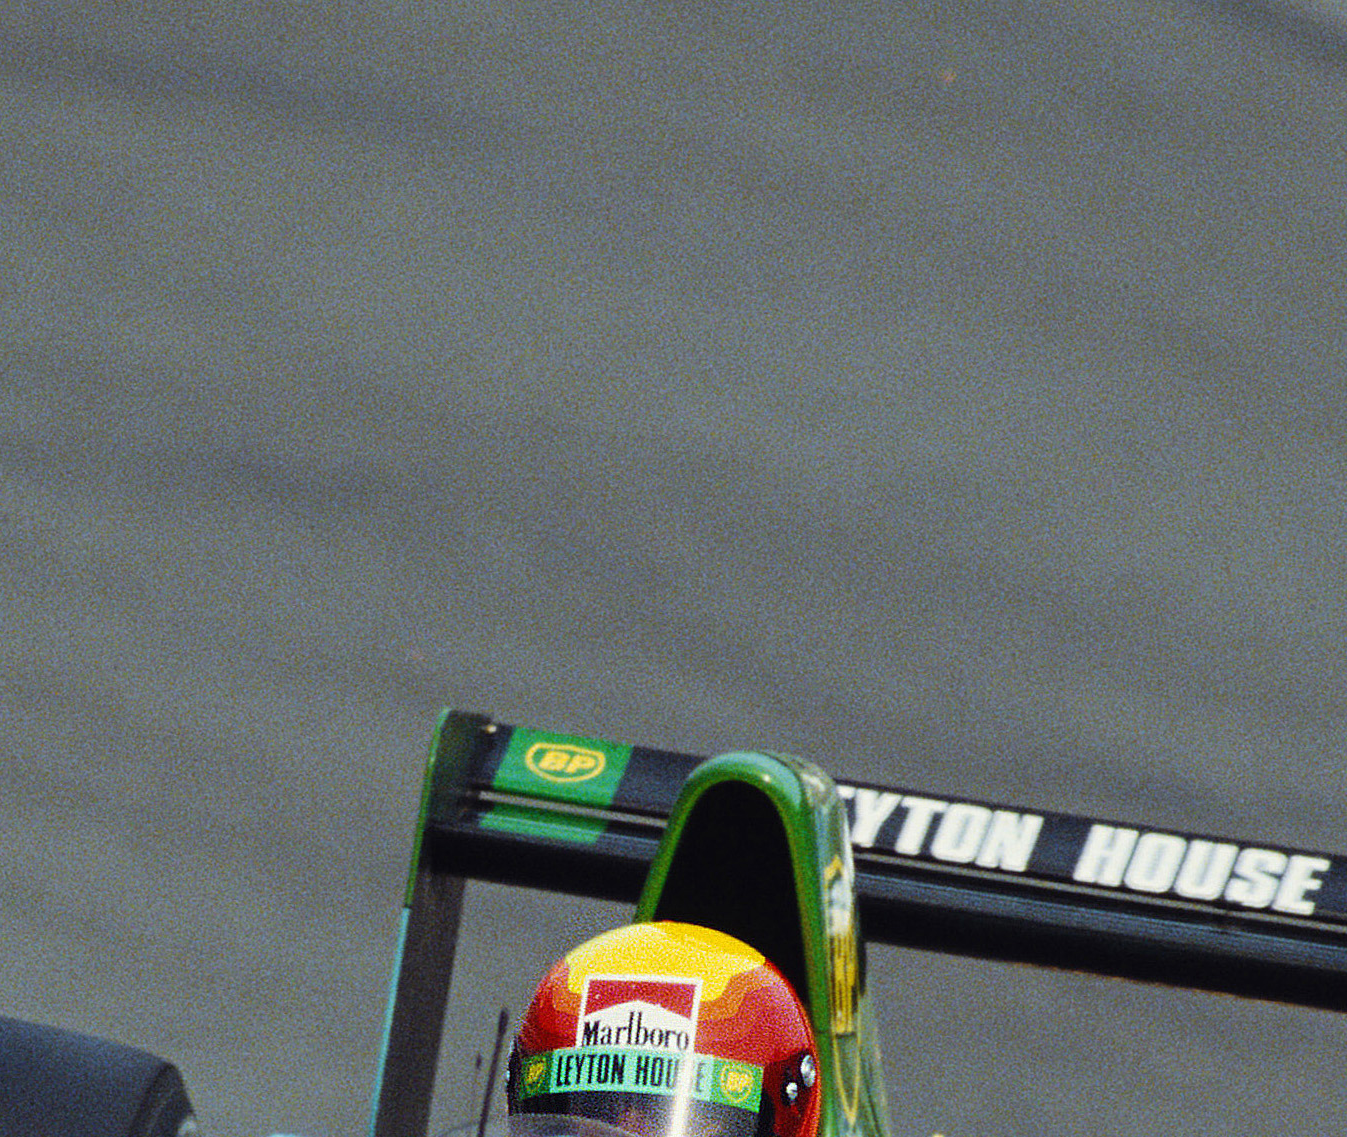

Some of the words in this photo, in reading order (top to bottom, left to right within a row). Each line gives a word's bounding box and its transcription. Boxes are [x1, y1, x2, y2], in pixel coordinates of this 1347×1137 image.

[836, 785, 1044, 872] YTON
[1072, 824, 1331, 916] HOUSE
[581, 1011, 689, 1050] Marlboro
[555, 1053, 627, 1087] LEYTON
[634, 1054, 706, 1093] HOUE
